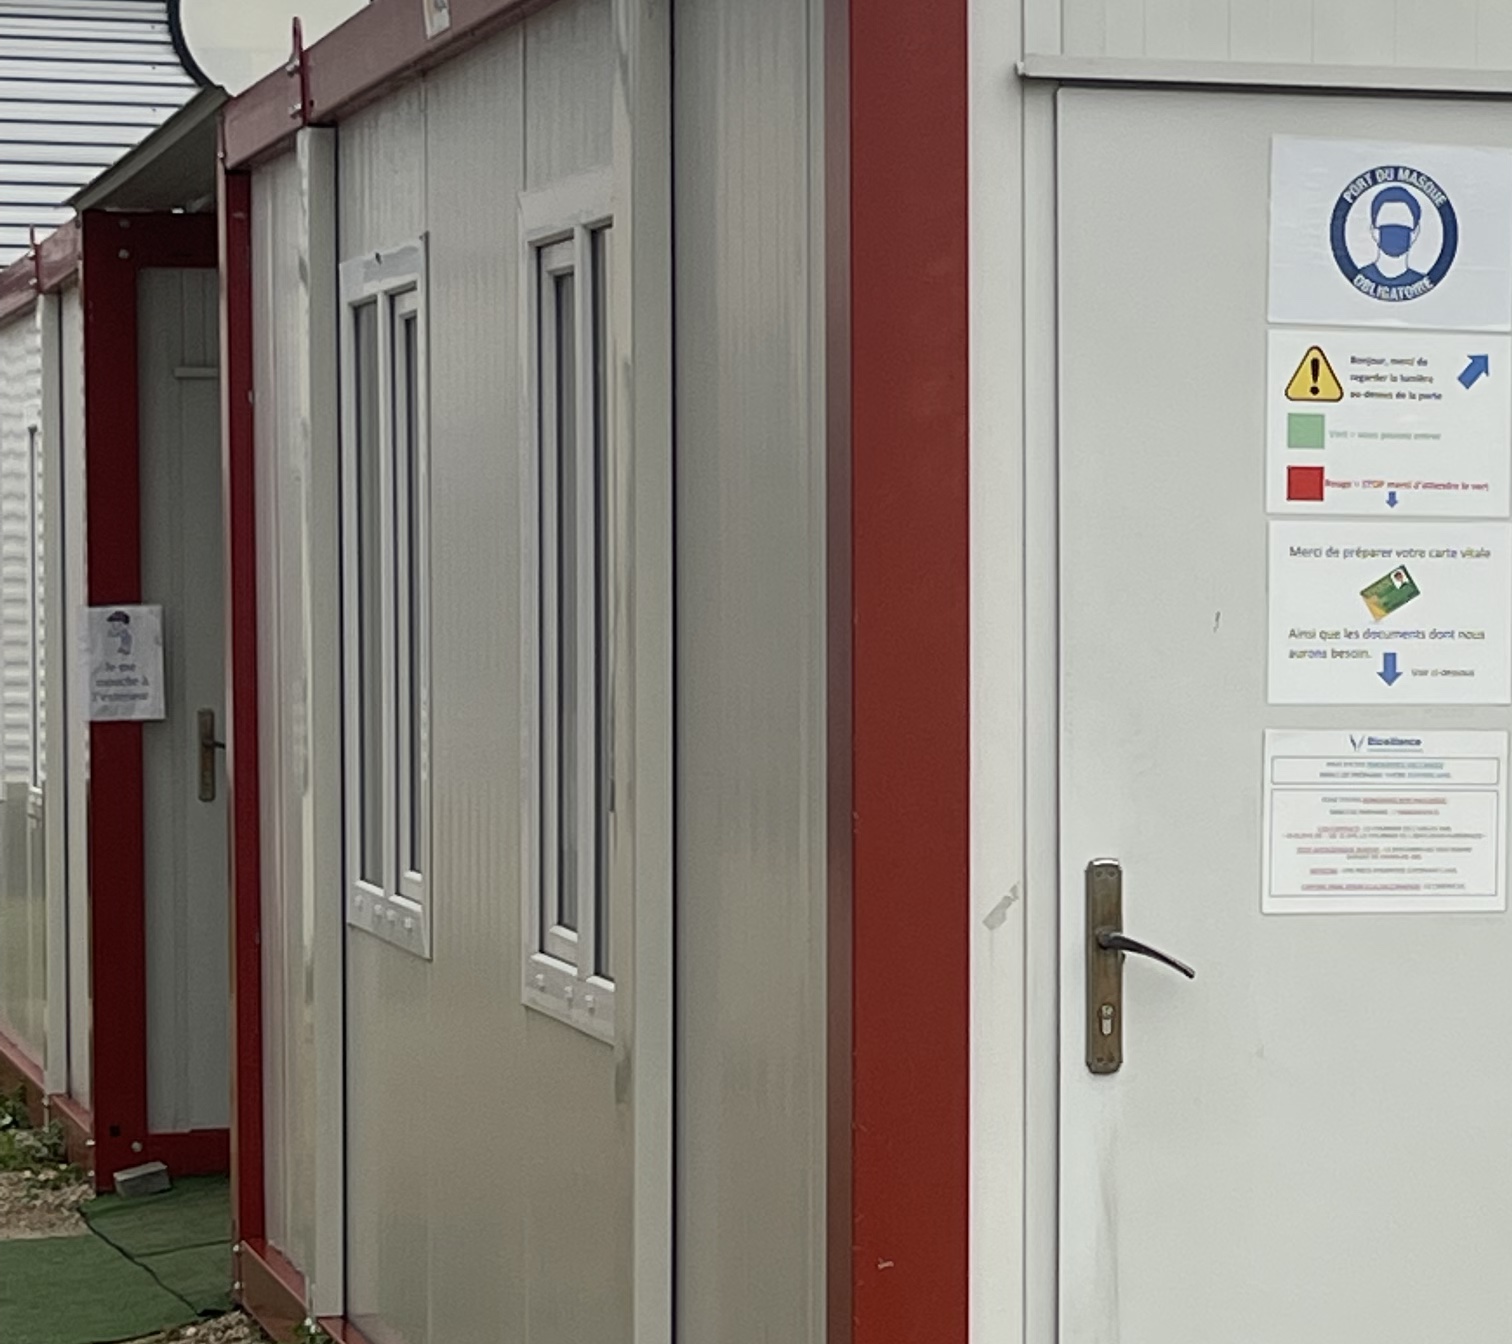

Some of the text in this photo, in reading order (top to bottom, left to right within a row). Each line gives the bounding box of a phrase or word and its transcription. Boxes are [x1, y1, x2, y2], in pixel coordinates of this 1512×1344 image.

[1343, 167, 1447, 207] PORT DU MASQUE
[1353, 273, 1434, 301] OBLIGATOIRE
[1417, 356, 1428, 367] de
[1396, 390, 1406, 400] de
[1289, 545, 1491, 560] Merci de préparer votre carte vitale
[1288, 628, 1485, 643] Ainsi que les documents dont nous
[1331, 647, 1372, 659] besoin.
